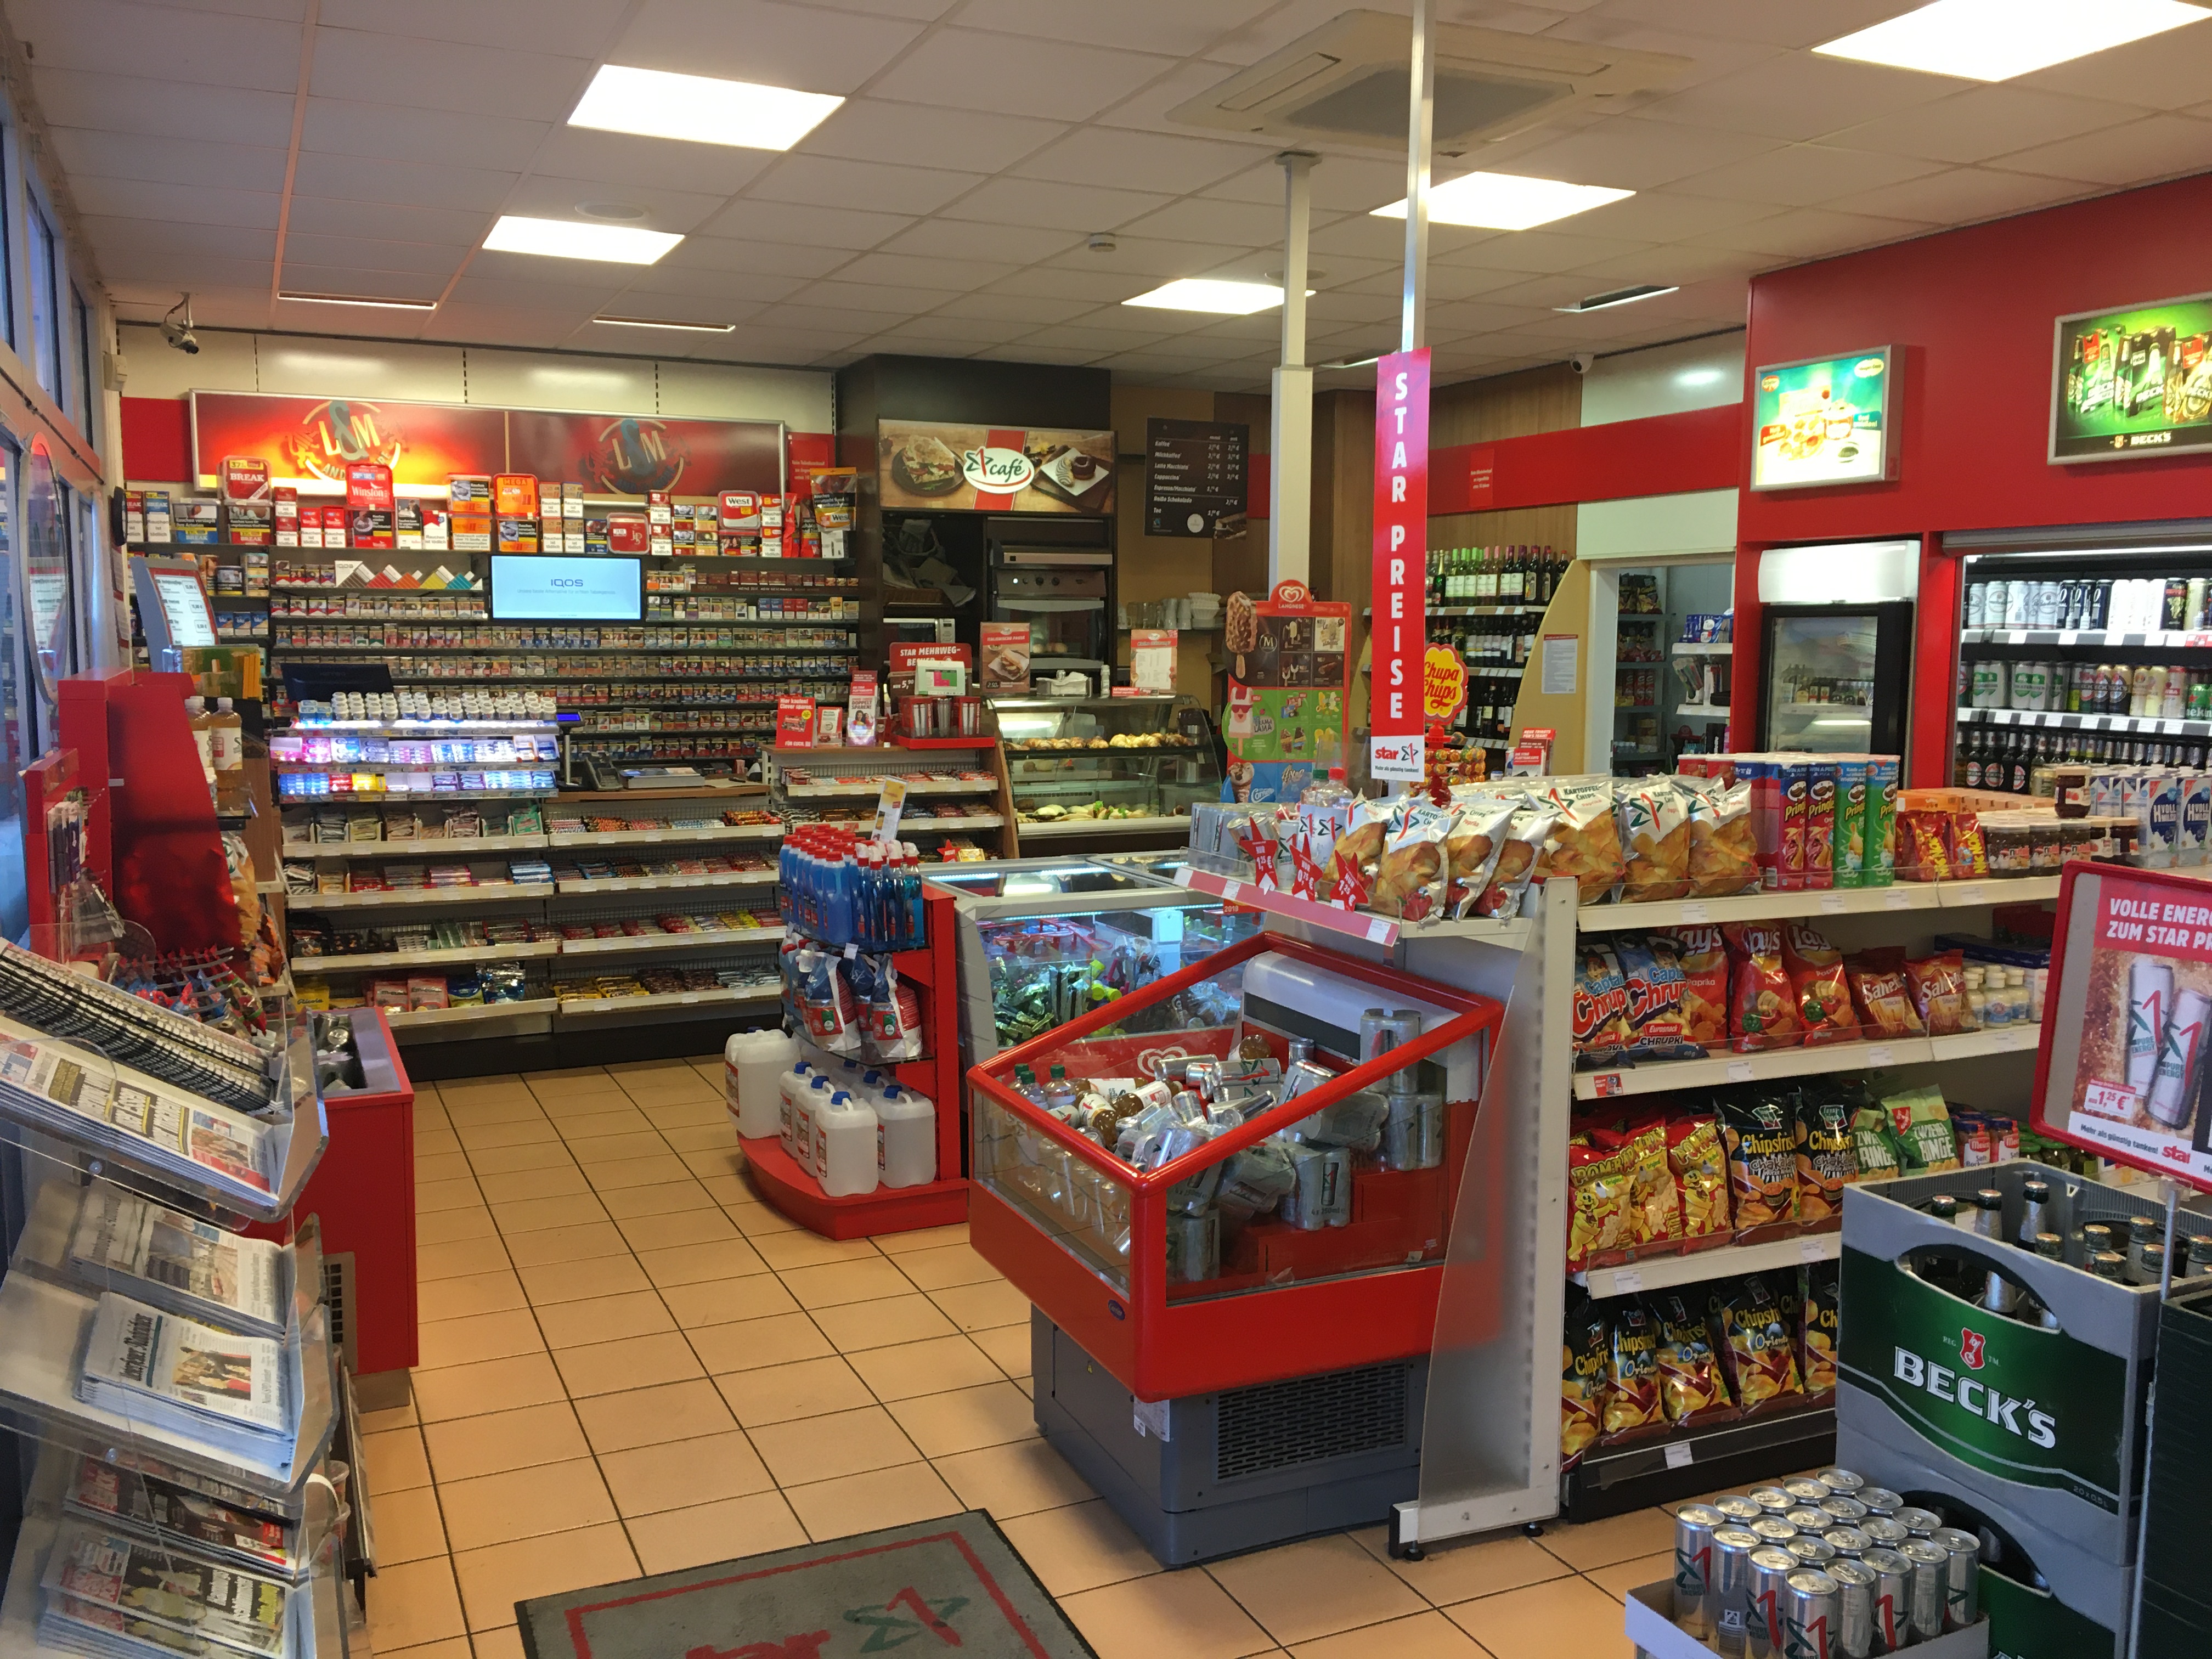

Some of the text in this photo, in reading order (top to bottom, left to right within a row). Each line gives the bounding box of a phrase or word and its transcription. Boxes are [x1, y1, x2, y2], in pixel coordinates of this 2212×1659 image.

[318, 400, 380, 460] L&M
[1391, 372, 1407, 503] STAR
[2131, 431, 2171, 447] BECK'S
[230, 473, 264, 482] BREAK
[989, 460, 1025, 483] café
[352, 486, 383, 497] Winston
[551, 579, 583, 588] IQOS
[1390, 525, 1406, 719] PREISE
[900, 646, 961, 657] STAR MEHRWEG-
[1375, 746, 1399, 760] star
[1564, 785, 1602, 795] KARTOFFEL-
[1785, 800, 1805, 821] Pring
[1808, 798, 1835, 819] Pringle
[1463, 819, 1480, 827] Paprika
[1301, 860, 1311, 872] NUR
[1308, 877, 1314, 890] €
[1344, 872, 1355, 889] NUR
[1339, 879, 1356, 906] 1,25 €
[2110, 898, 2212, 927] VOLLE ENER
[2107, 921, 2143, 941] ZUM
[2146, 926, 2190, 947] STAR
[1686, 978, 1716, 986] Paprika
[1649, 1024, 1678, 1033] Eurosnack
[1640, 1036, 1684, 1046] CHRUPKI
[2131, 1043, 2155, 1054] ENERGY
[2137, 1036, 2154, 1046] PURE
[2158, 1068, 2185, 1079] ENERGY
[2166, 1061, 2185, 1071] PURE
[2098, 1091, 2116, 1107] 1,25
[1742, 1132, 1796, 1156] Chipsfris
[2080, 1124, 2097, 1135] Mehr
[2108, 1132, 2131, 1147] günstig
[2133, 1139, 2158, 1154] tanken!
[1918, 1137, 1955, 1161] RINGE
[1750, 1154, 1796, 1171] Chakala
[1605, 1175, 1624, 1186] Original
[1736, 1306, 1781, 1329] Chipsfri
[1942, 1335, 1956, 1347] REG
[1893, 1345, 2056, 1449] BECK'S
